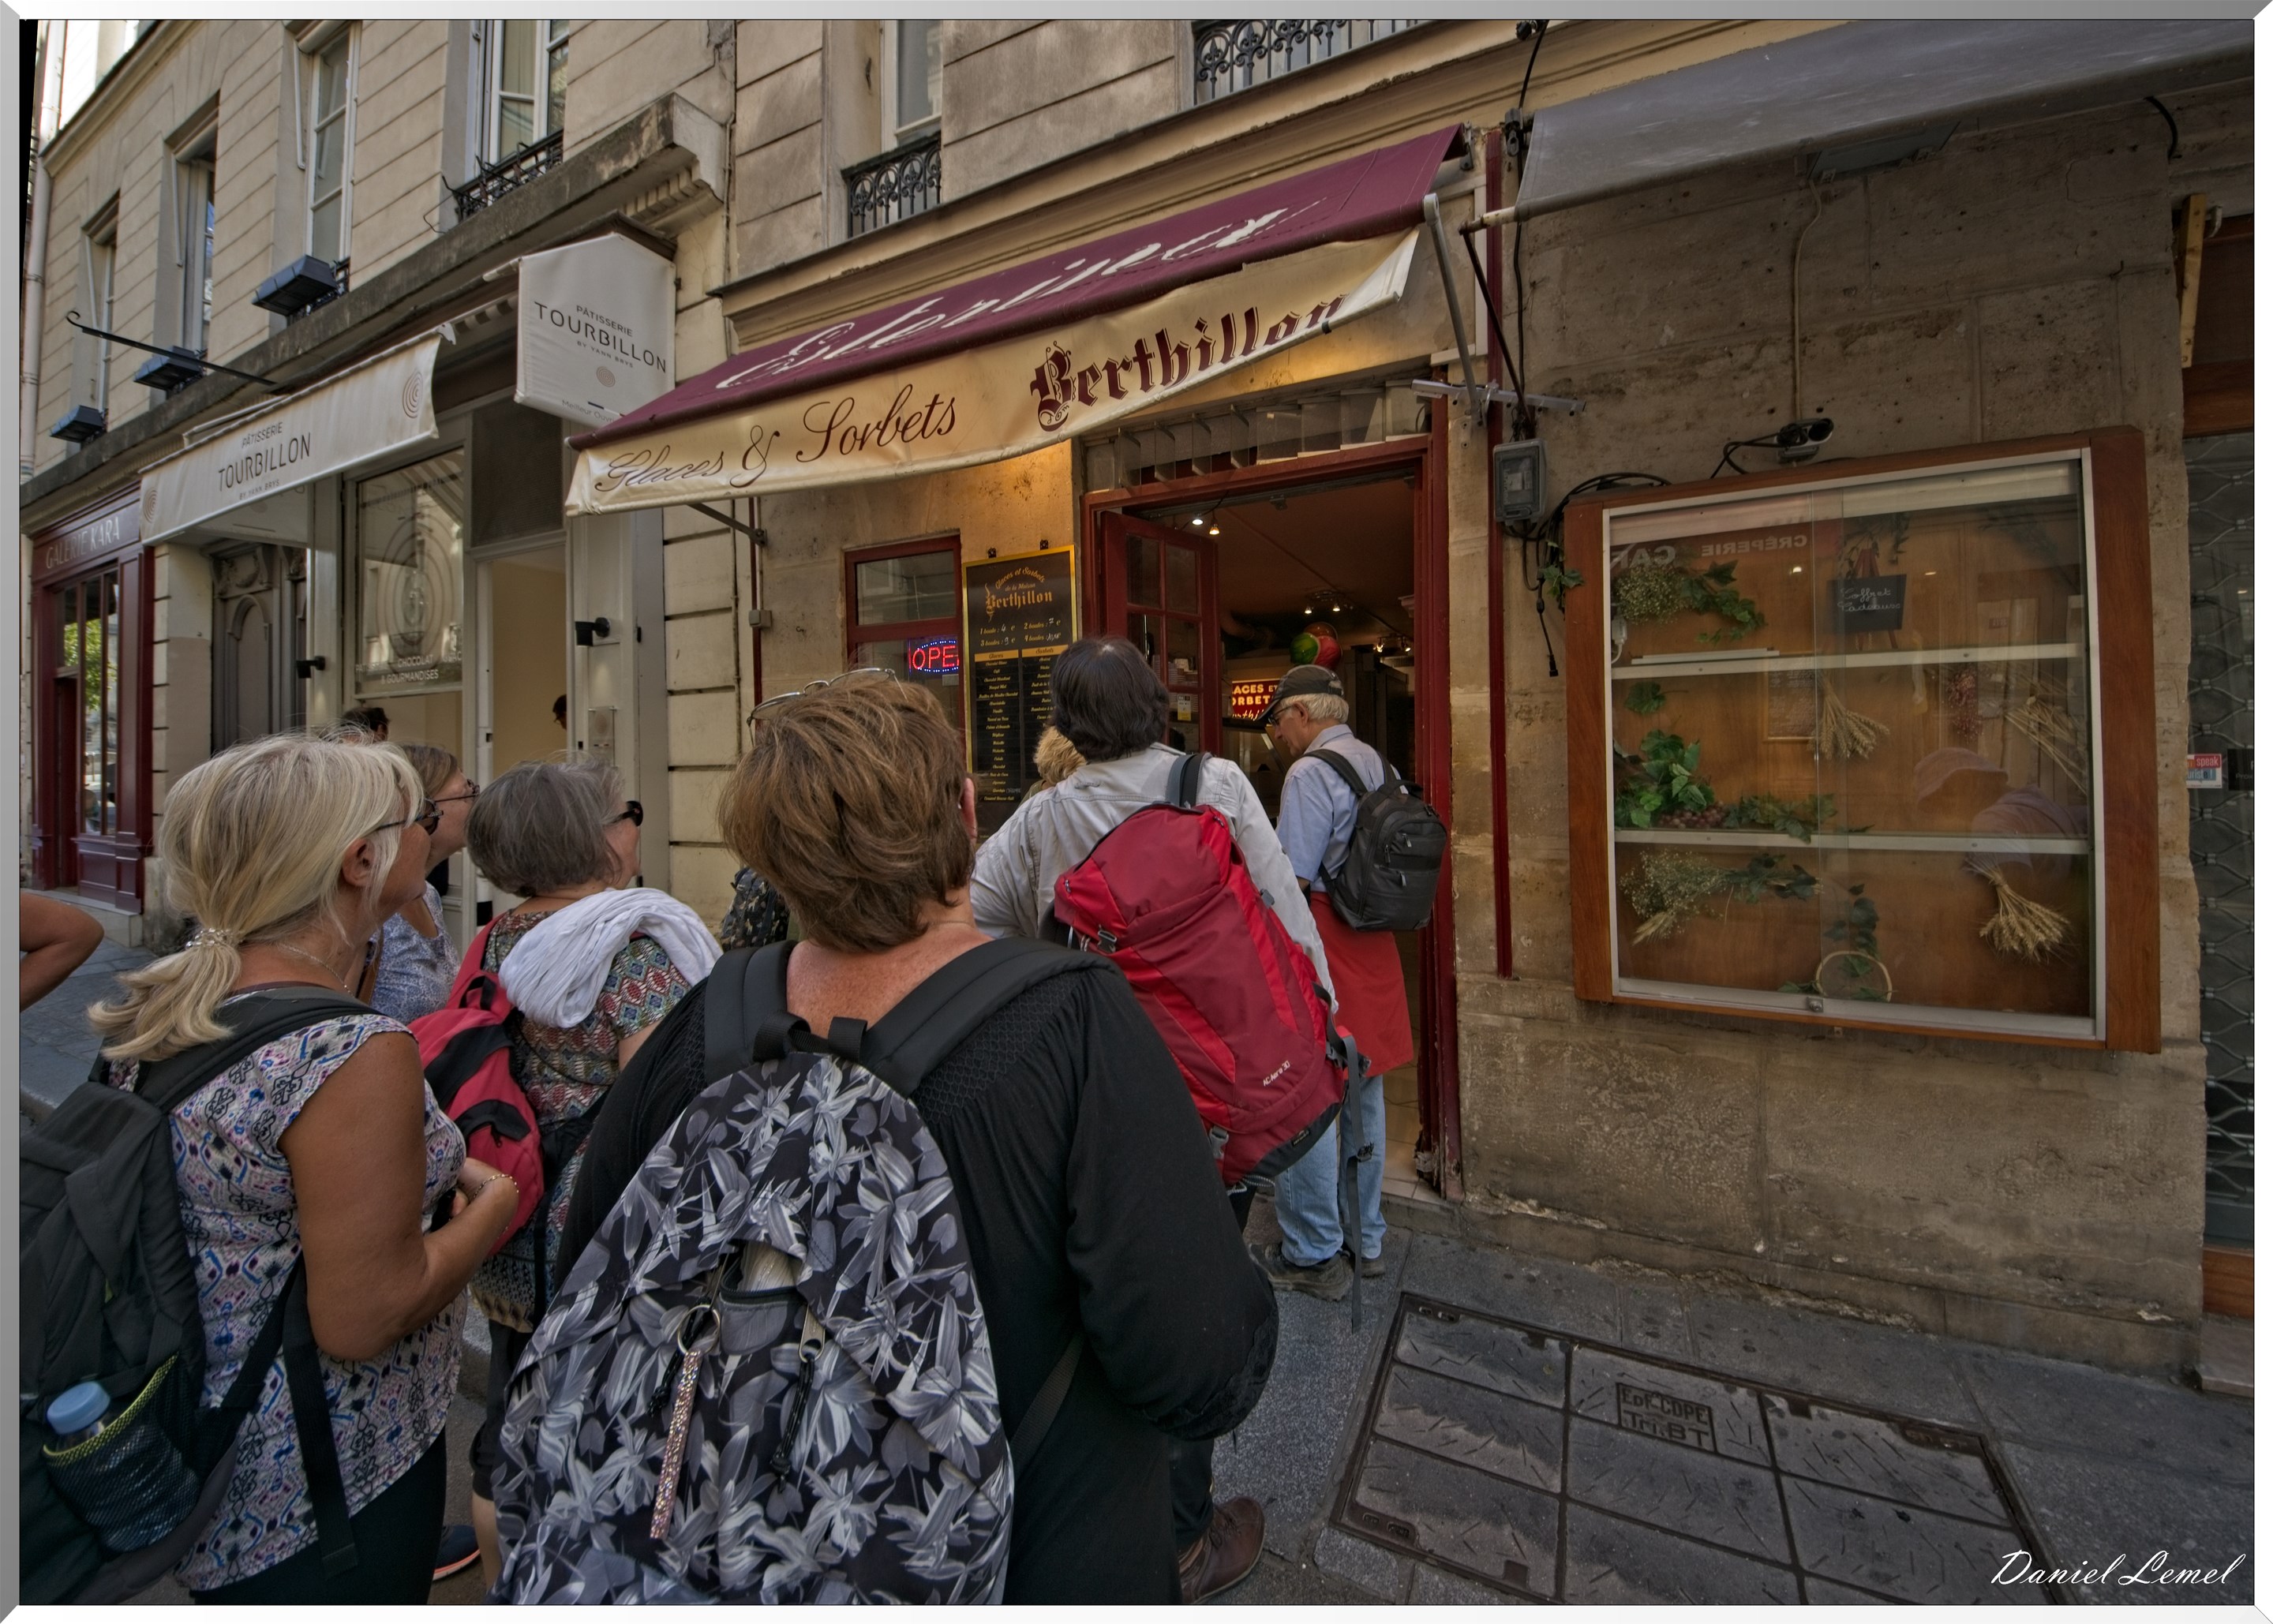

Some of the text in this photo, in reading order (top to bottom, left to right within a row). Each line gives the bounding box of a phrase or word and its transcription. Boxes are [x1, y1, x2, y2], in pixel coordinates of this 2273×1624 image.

[534, 301, 666, 374] TOURBILLON
[591, 346, 612, 359] YANN
[615, 356, 634, 368] BRYS
[1030, 294, 1350, 432] Berthillon
[561, 399, 615, 423] Meilleur Ouvri
[594, 384, 956, 492] Glaces & Sorbets
[218, 432, 311, 492] TOURBILLON
[248, 486, 262, 496] YANN
[264, 479, 279, 490] BRYS
[46, 516, 120, 569] GALERIE KARA
[995, 567, 1046, 589] Glaces et Sorbets
[985, 586, 1053, 617] Berthillon
[1840, 587, 1891, 604] Coffret
[398, 654, 434, 668] CHOCOLAT
[912, 645, 959, 670] OPE
[387, 669, 439, 684] GOURMANDISES
[1232, 683, 1264, 694] ACES
[1232, 695, 1271, 706] RBET
[2196, 756, 2219, 767] speak
[2187, 769, 2208, 780] uriste
[1263, 1060, 1290, 1087] AC Aero 30
